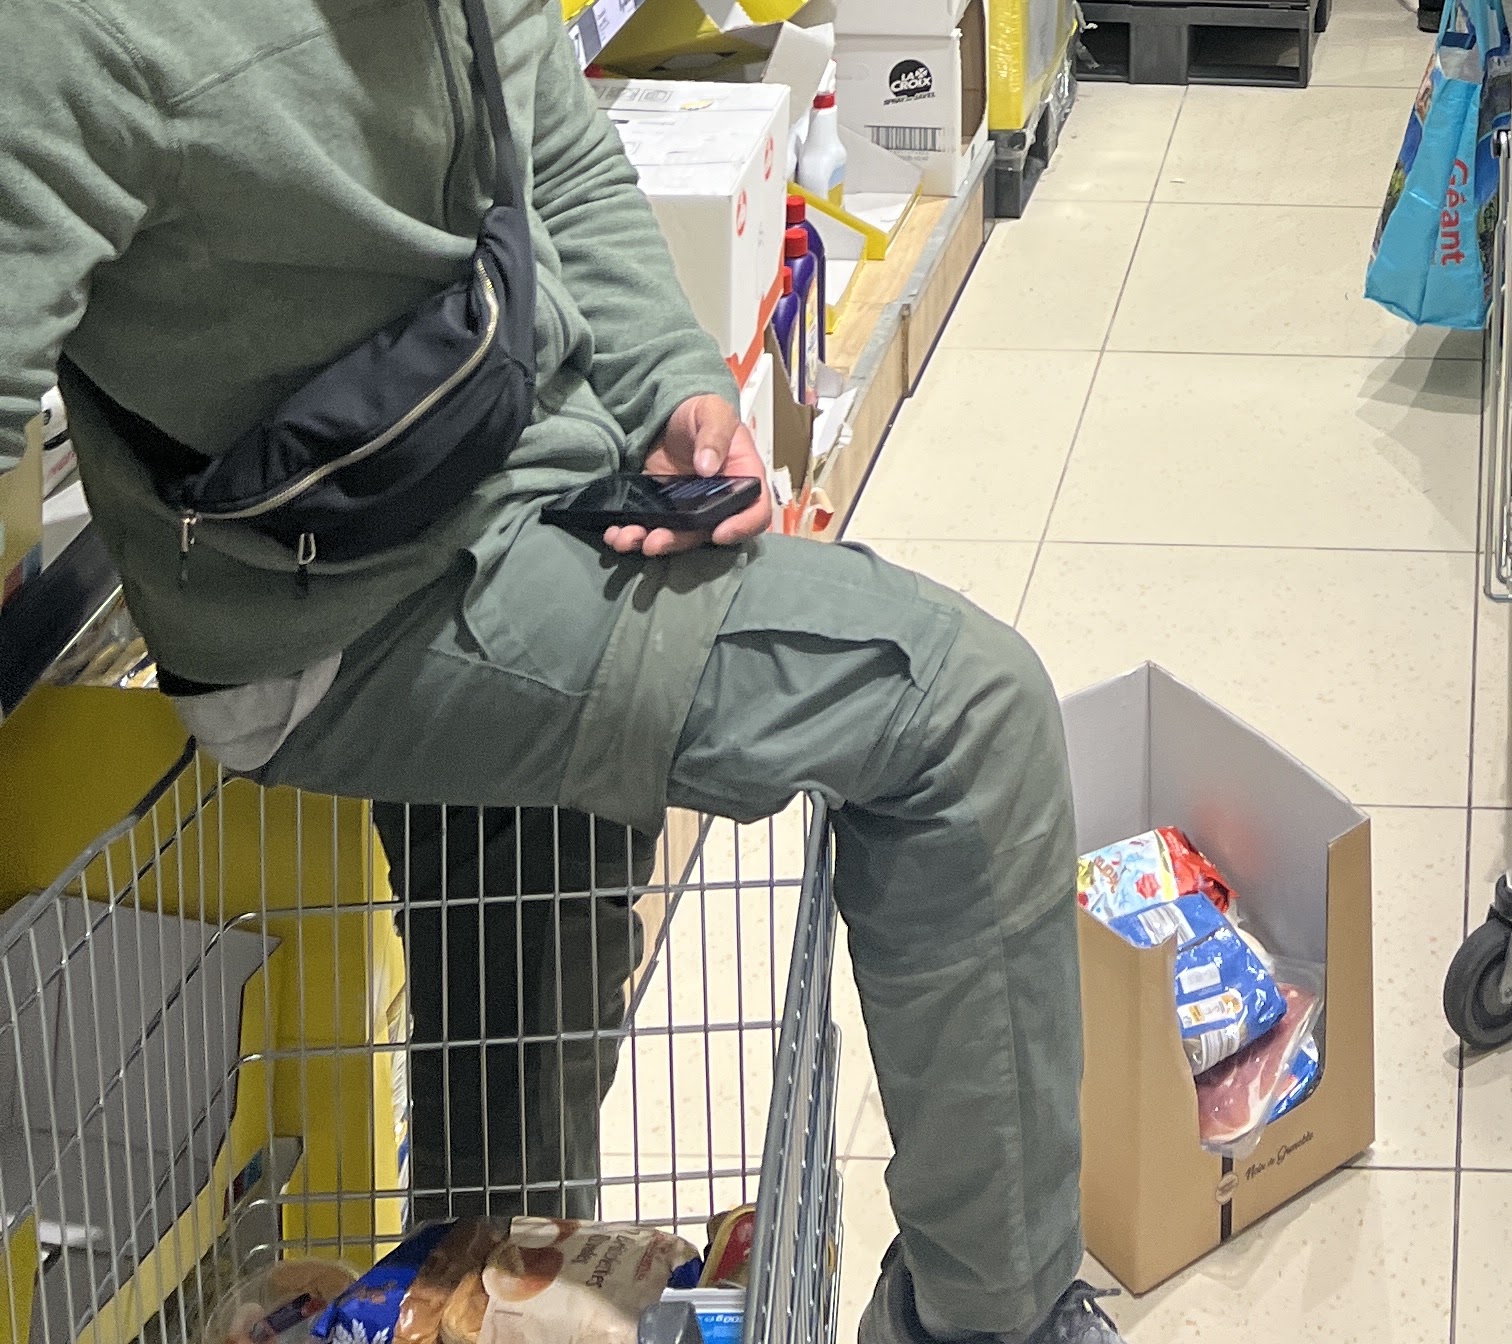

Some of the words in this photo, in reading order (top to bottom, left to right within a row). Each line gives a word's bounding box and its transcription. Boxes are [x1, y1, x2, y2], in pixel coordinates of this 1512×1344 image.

[890, 77, 932, 92] CROIX
[1441, 158, 1471, 266] Géant
[1245, 1163, 1265, 1180] Noix
